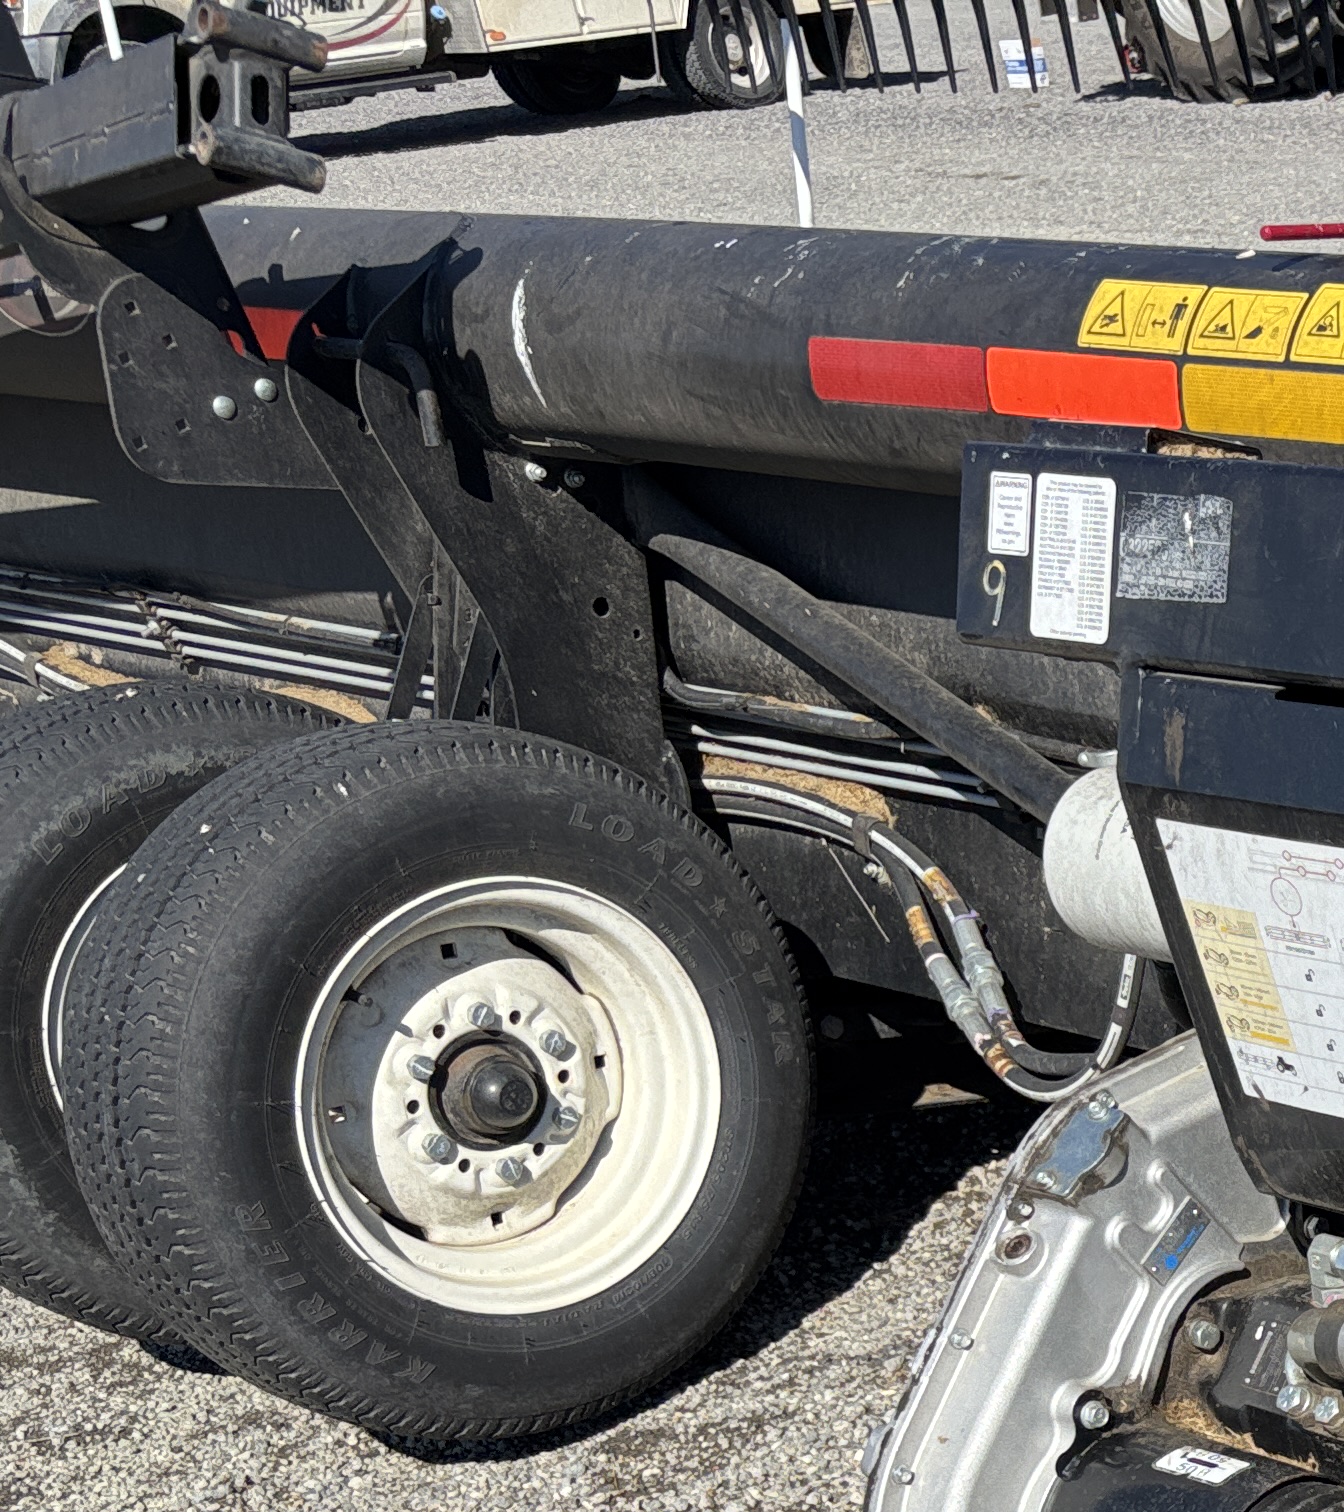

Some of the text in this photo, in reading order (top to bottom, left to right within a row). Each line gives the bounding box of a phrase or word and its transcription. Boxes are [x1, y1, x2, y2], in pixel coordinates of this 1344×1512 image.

[983, 560, 1007, 627] 9
[30, 767, 168, 866] LOAD
[568, 802, 704, 887] LOAD
[731, 929, 799, 1066] STAR
[233, 1200, 438, 1385] KARRIER
